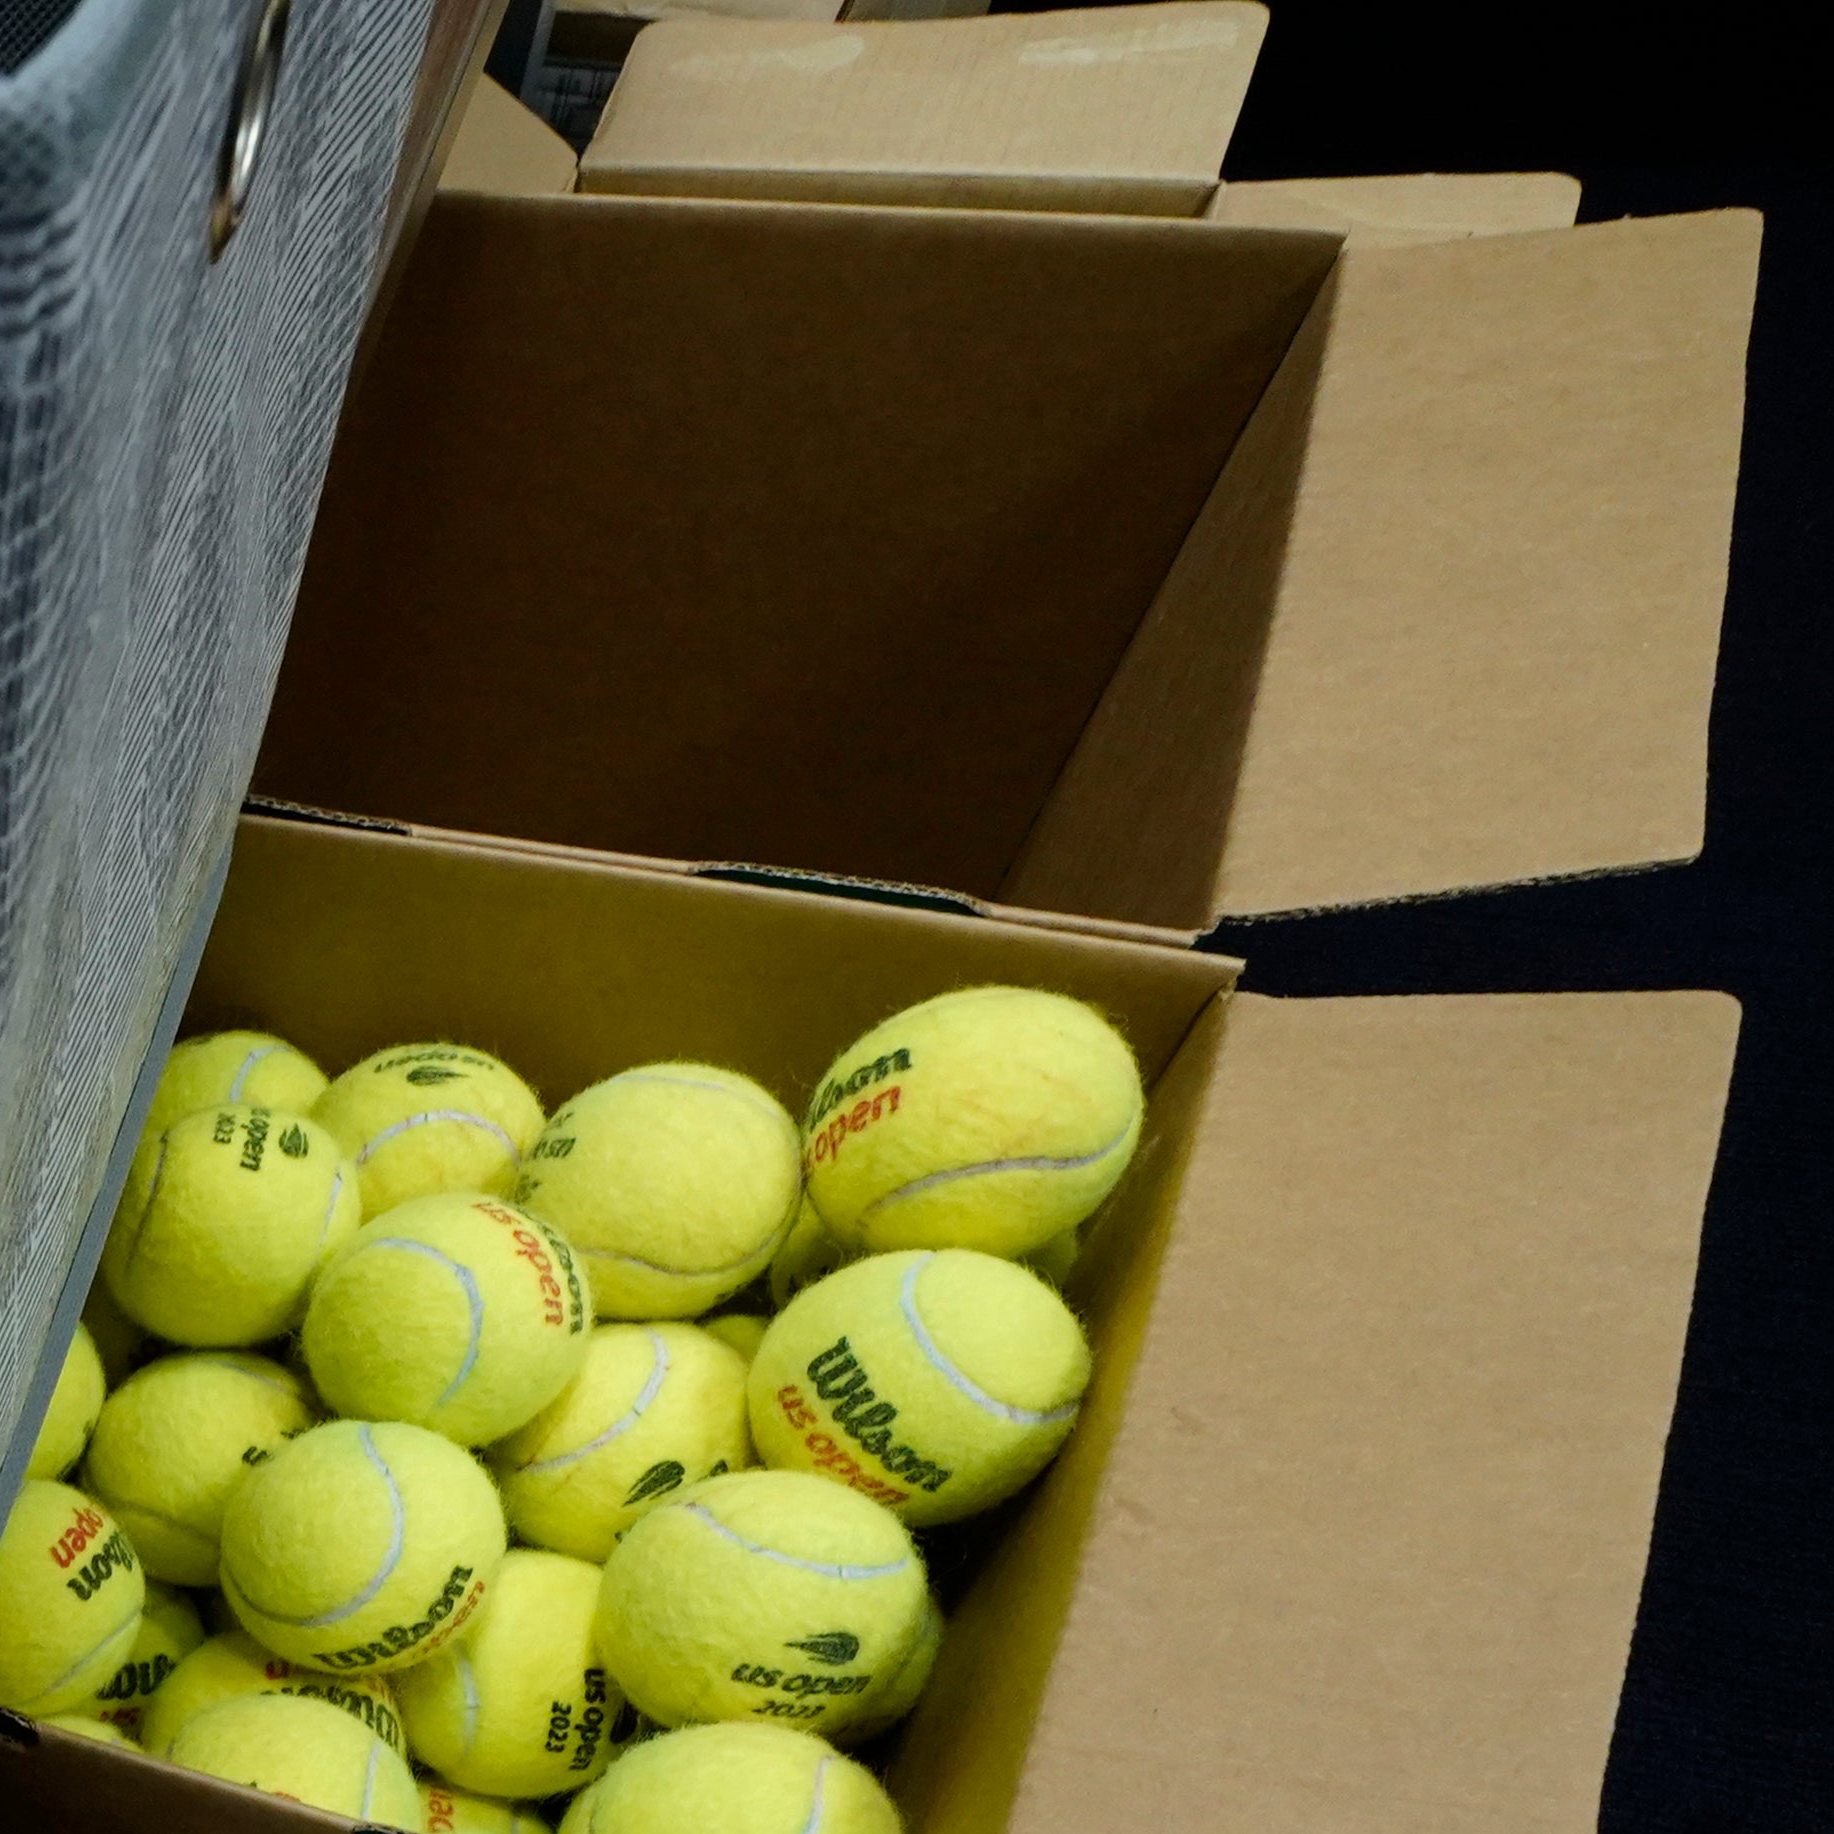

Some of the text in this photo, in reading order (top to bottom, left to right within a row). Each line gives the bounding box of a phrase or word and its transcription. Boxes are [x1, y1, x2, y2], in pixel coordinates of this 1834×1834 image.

[815, 1086, 901, 1161] open
[513, 1229, 564, 1326] open
[778, 1384, 911, 1505] us open
[807, 1336, 954, 1493] Wilson
[312, 1565, 474, 1669] Wilson
[545, 1701, 572, 1753] 2023
[781, 1674, 872, 1700] open
[568, 1706, 604, 1771] open
